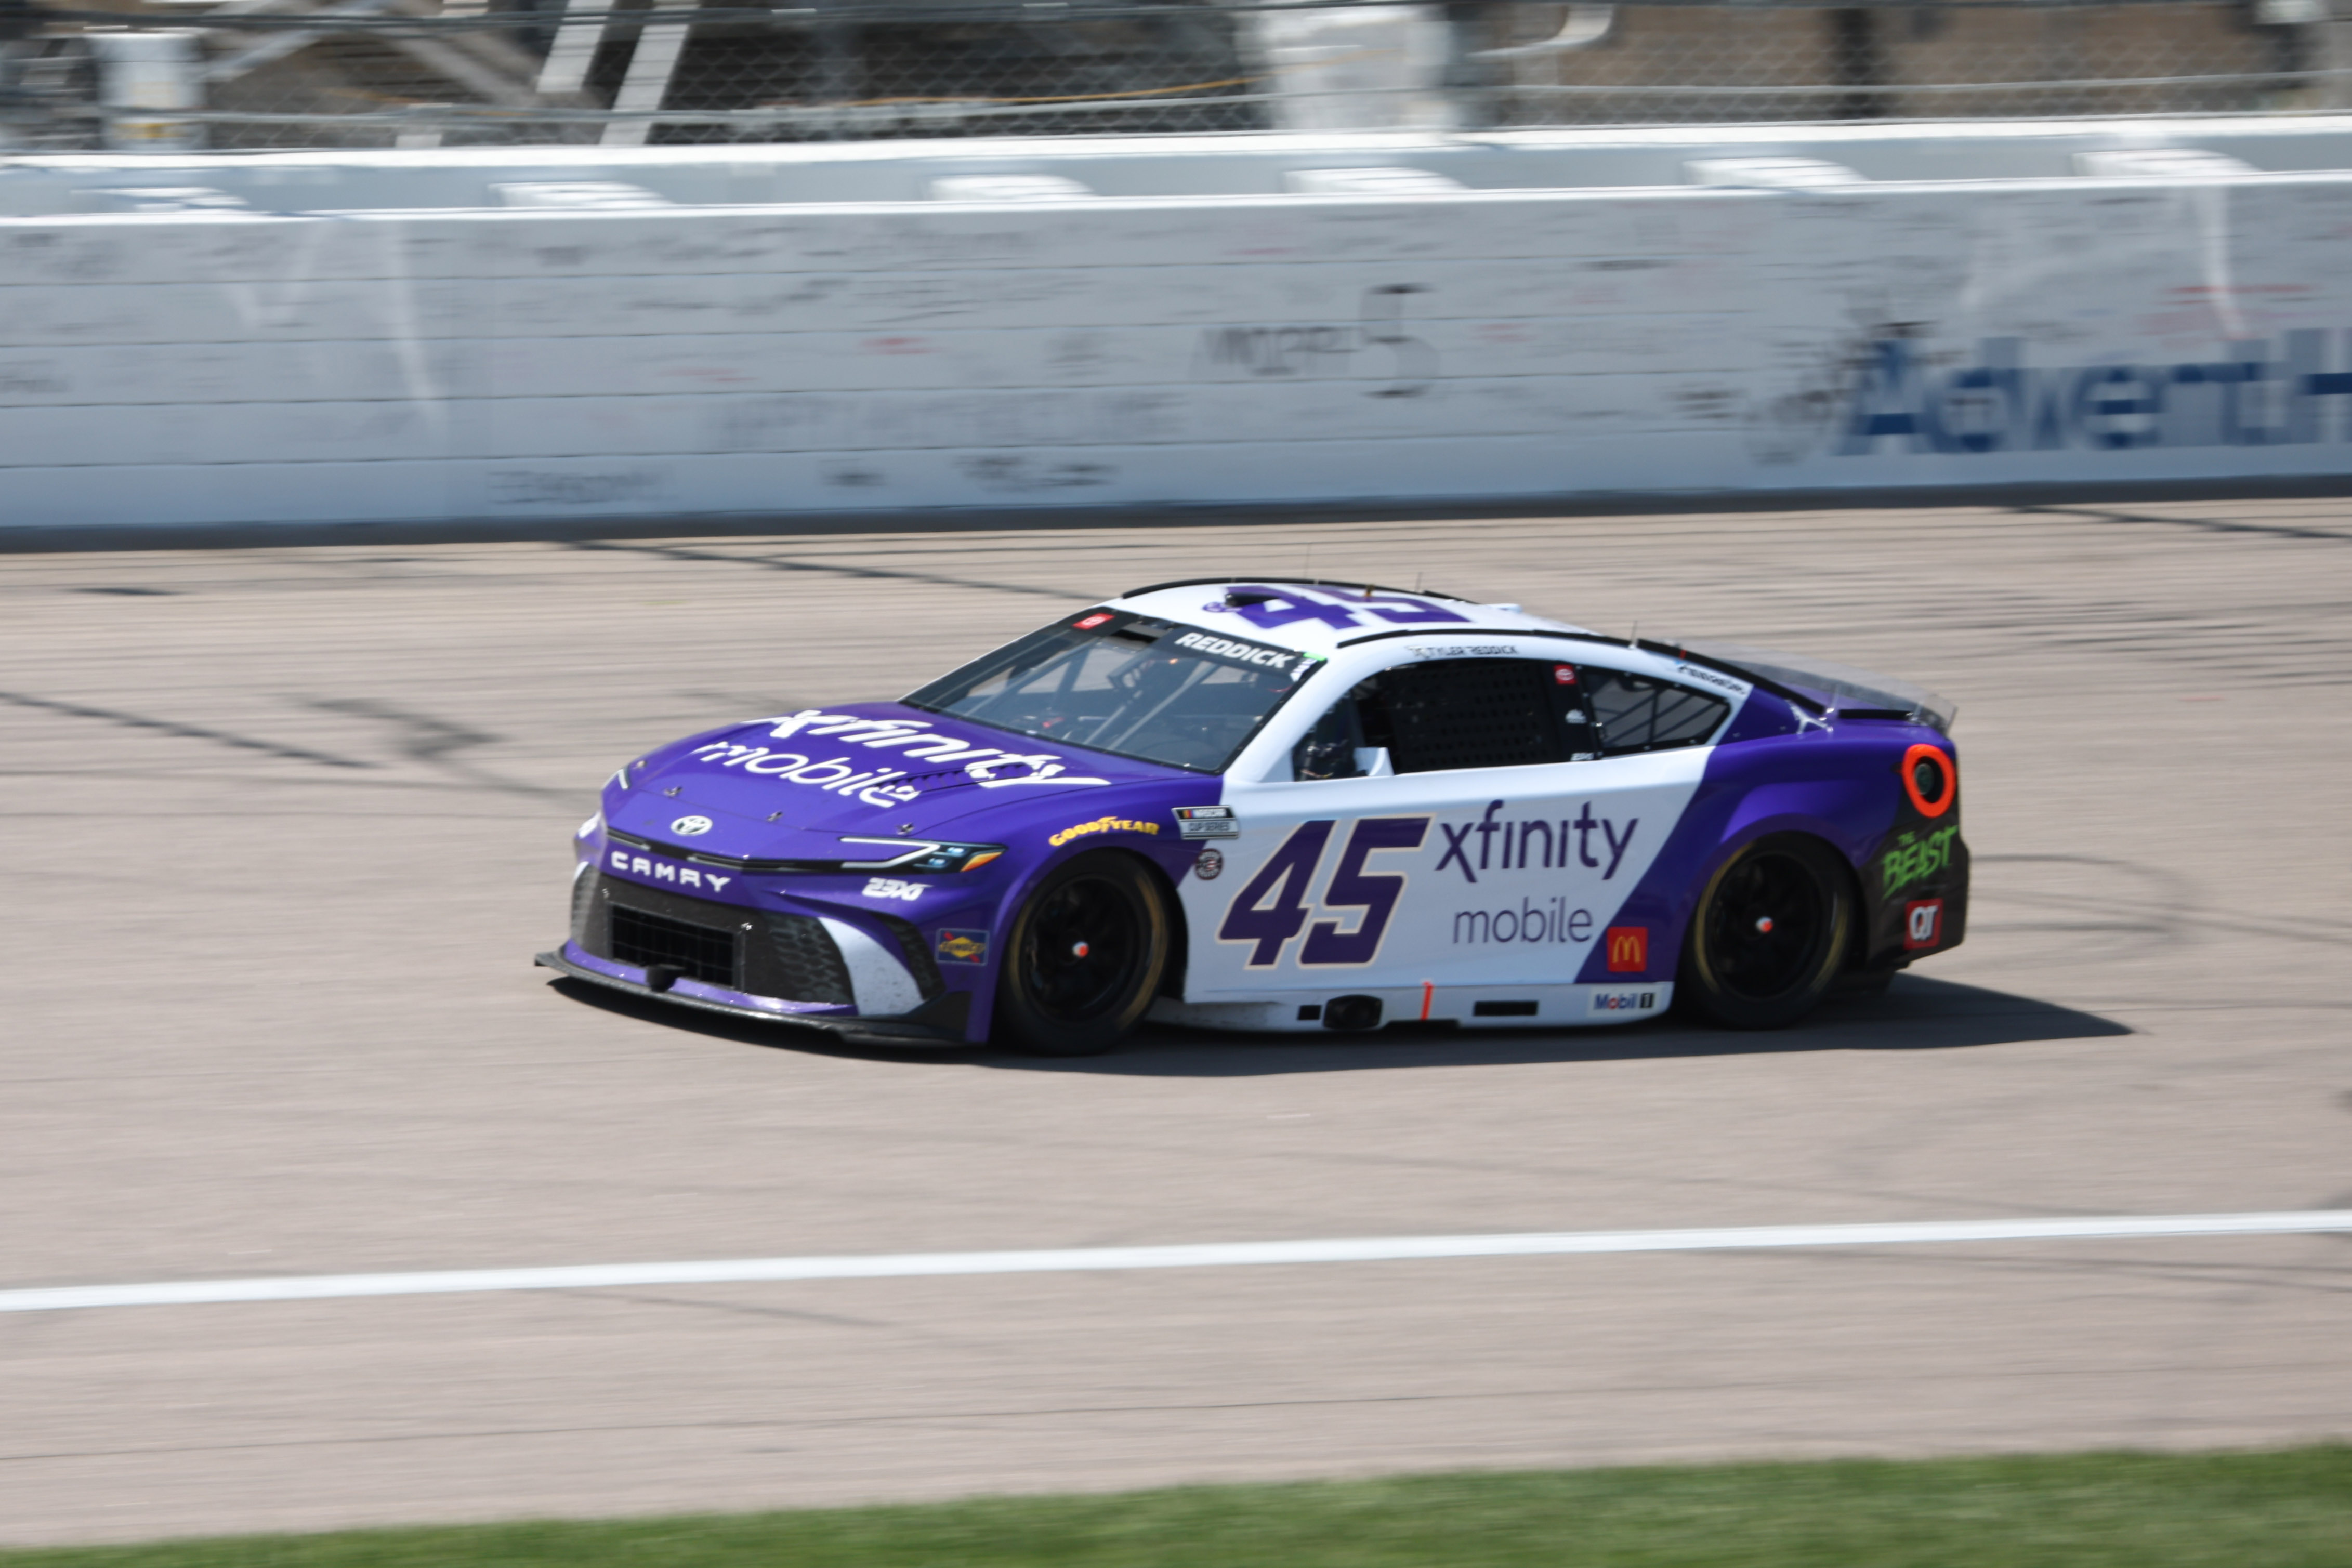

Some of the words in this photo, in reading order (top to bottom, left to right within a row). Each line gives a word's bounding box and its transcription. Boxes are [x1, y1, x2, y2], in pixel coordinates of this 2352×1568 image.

[1174, 632, 1296, 668] REDDICK
[689, 741, 922, 807] mobile
[1048, 816, 1160, 846] GOODYEAR
[1434, 799, 1639, 884] xfinity
[611, 851, 731, 892] CAMRY
[1881, 825, 1959, 900] BEAST
[1216, 813, 1436, 970] 45
[1453, 896, 1593, 943] mobile
[1909, 905, 1938, 941] QT
[1594, 993, 1638, 1010] Mobil
